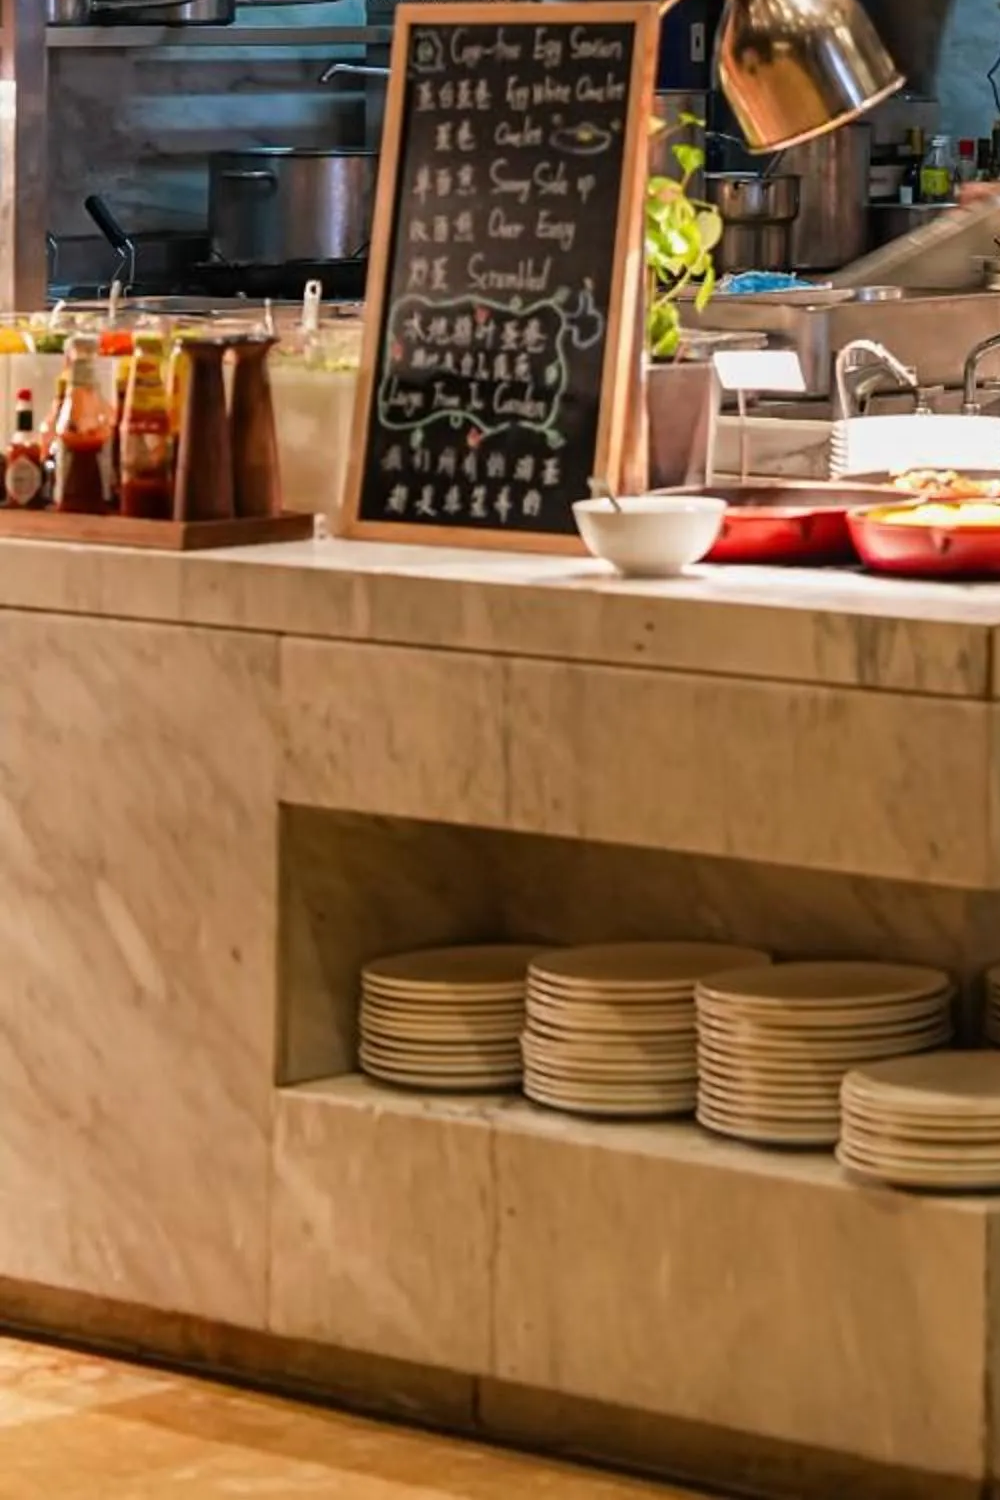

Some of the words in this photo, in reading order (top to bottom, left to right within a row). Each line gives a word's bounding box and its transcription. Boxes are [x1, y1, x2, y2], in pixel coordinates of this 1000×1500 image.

[533, 26, 562, 67] Egg
[488, 207, 525, 238] Over
[535, 209, 576, 251] Easy
